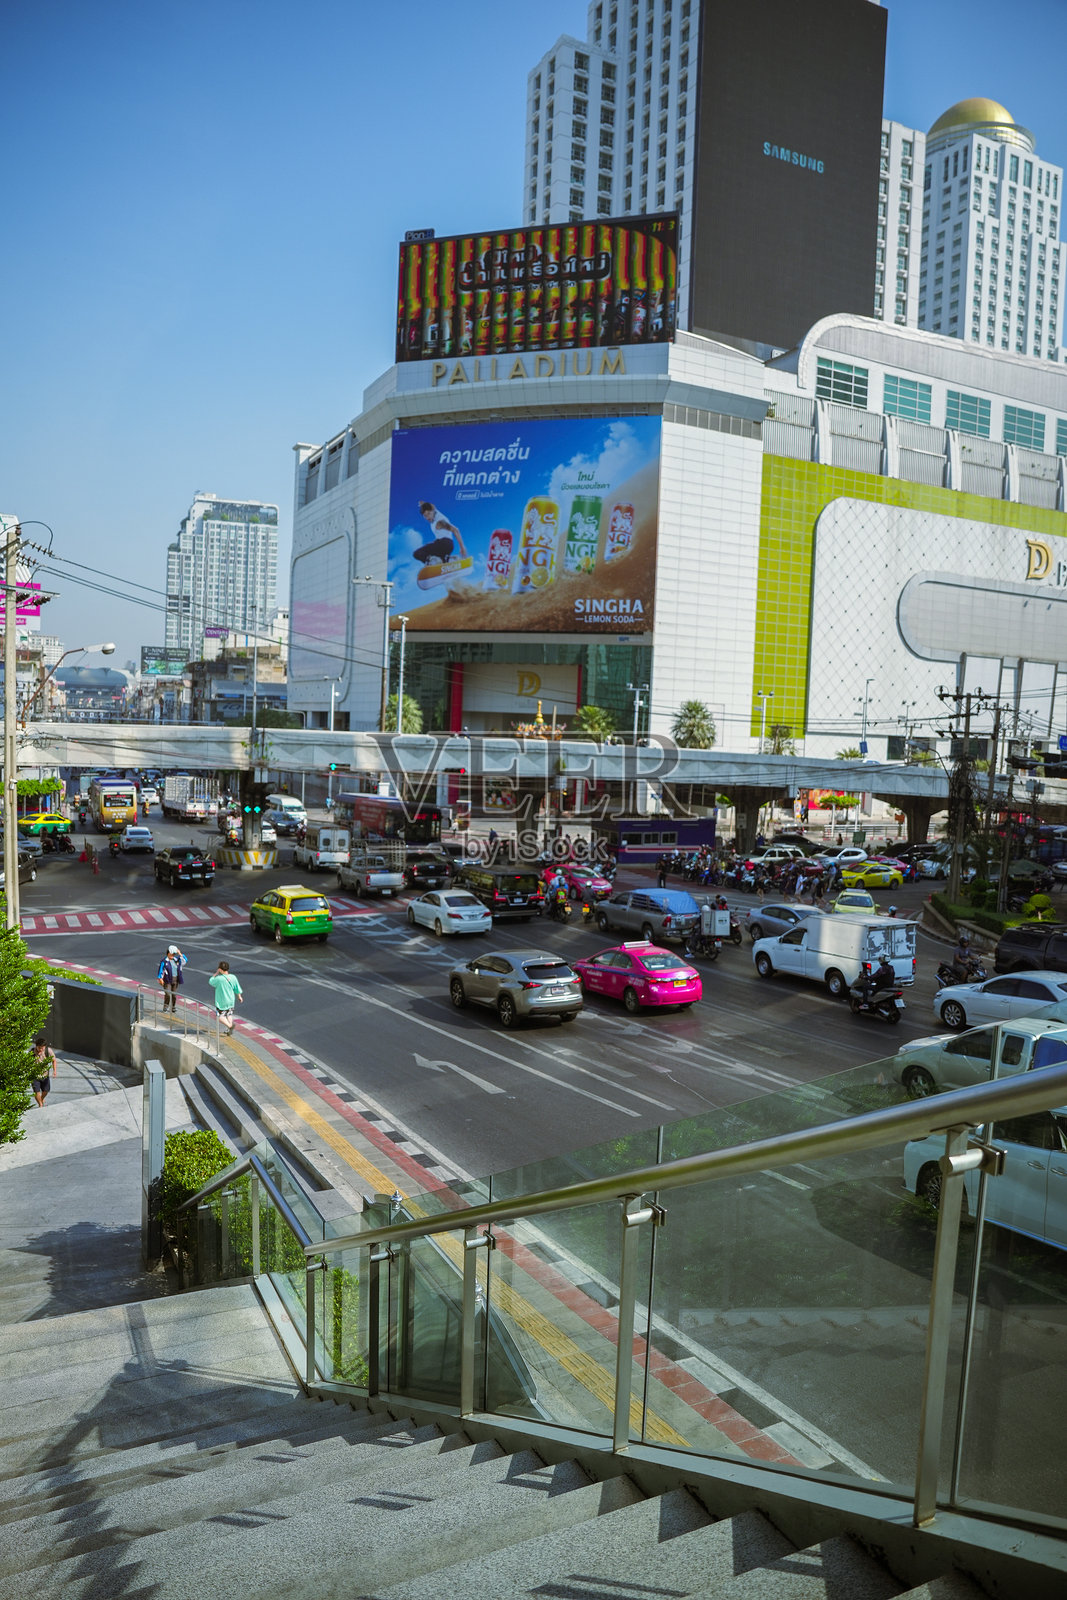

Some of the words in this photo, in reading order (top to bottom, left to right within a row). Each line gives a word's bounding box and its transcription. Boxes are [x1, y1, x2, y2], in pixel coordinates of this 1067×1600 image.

[763, 141, 824, 174] SAMSUNG
[432, 348, 626, 387] PALLADIUM
[439, 437, 530, 464] ความสดชื่น
[442, 464, 521, 486] ที่แตกต่าง
[577, 471, 595, 482] ใหม่
[574, 599, 643, 613] SINGHA
[584, 615, 611, 623] LEMON
[613, 615, 634, 623] SODA
